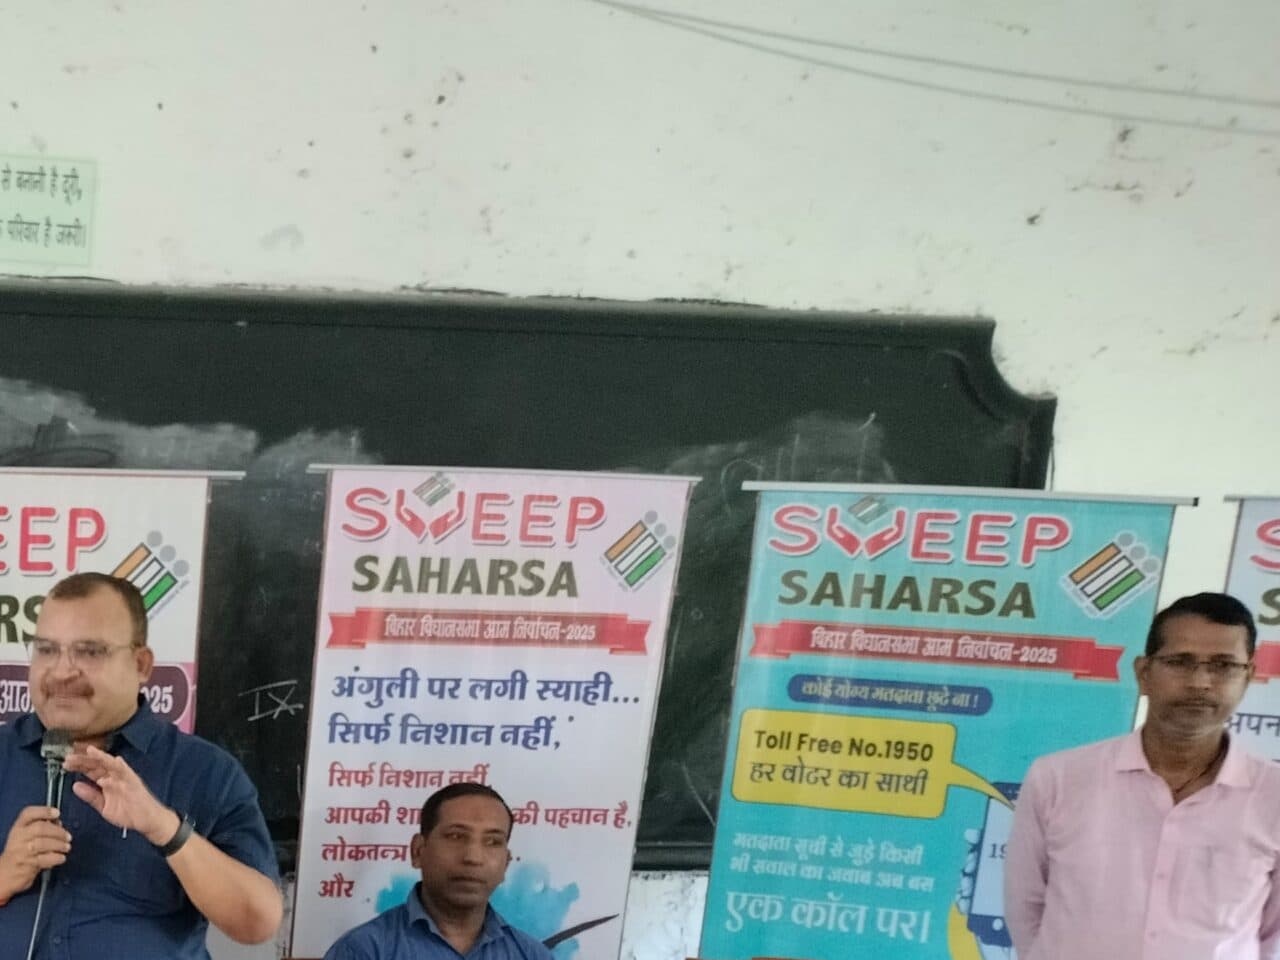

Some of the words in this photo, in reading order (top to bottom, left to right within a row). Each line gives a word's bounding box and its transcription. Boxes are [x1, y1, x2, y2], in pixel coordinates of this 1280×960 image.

[342, 487, 605, 545] SWEEP
[769, 505, 1070, 566] SWEEP
[351, 555, 579, 598] SAHARSA
[778, 569, 1036, 619] SAHARSA
[385, 614, 416, 637] बिहार
[420, 614, 479, 638] विधानसभा
[484, 618, 510, 639] आम
[810, 626, 846, 649] बिहार
[850, 628, 920, 655] विधानसभा
[922, 636, 954, 658] आम
[331, 666, 420, 708] अंगुली
[427, 677, 462, 701] पर
[469, 670, 527, 702] लगी
[801, 676, 832, 699] कोई
[872, 686, 923, 706] मतदाता
[328, 712, 392, 744] सिर्फ
[399, 713, 493, 747] निशान
[755, 731, 791, 751] Toll
[798, 733, 842, 755] Free
[849, 737, 933, 762] No.1950
[328, 761, 376, 789] सिर्फ
[379, 762, 444, 788] निशान
[750, 761, 776, 784] हर
[783, 756, 831, 787] वोटर
[838, 768, 868, 790] का
[877, 769, 929, 797] साथी
[324, 800, 389, 825] आपकी
[544, 807, 608, 828] पहचान
[321, 836, 409, 862] लोकतन्त्र
[733, 832, 791, 852] मतदाता
[830, 836, 844, 857] से
[879, 841, 924, 865] किसी
[730, 853, 750, 873] भी
[800, 863, 824, 880] का
[318, 872, 356, 898] और
[725, 891, 785, 932] एक
[791, 891, 869, 934] कॉल
